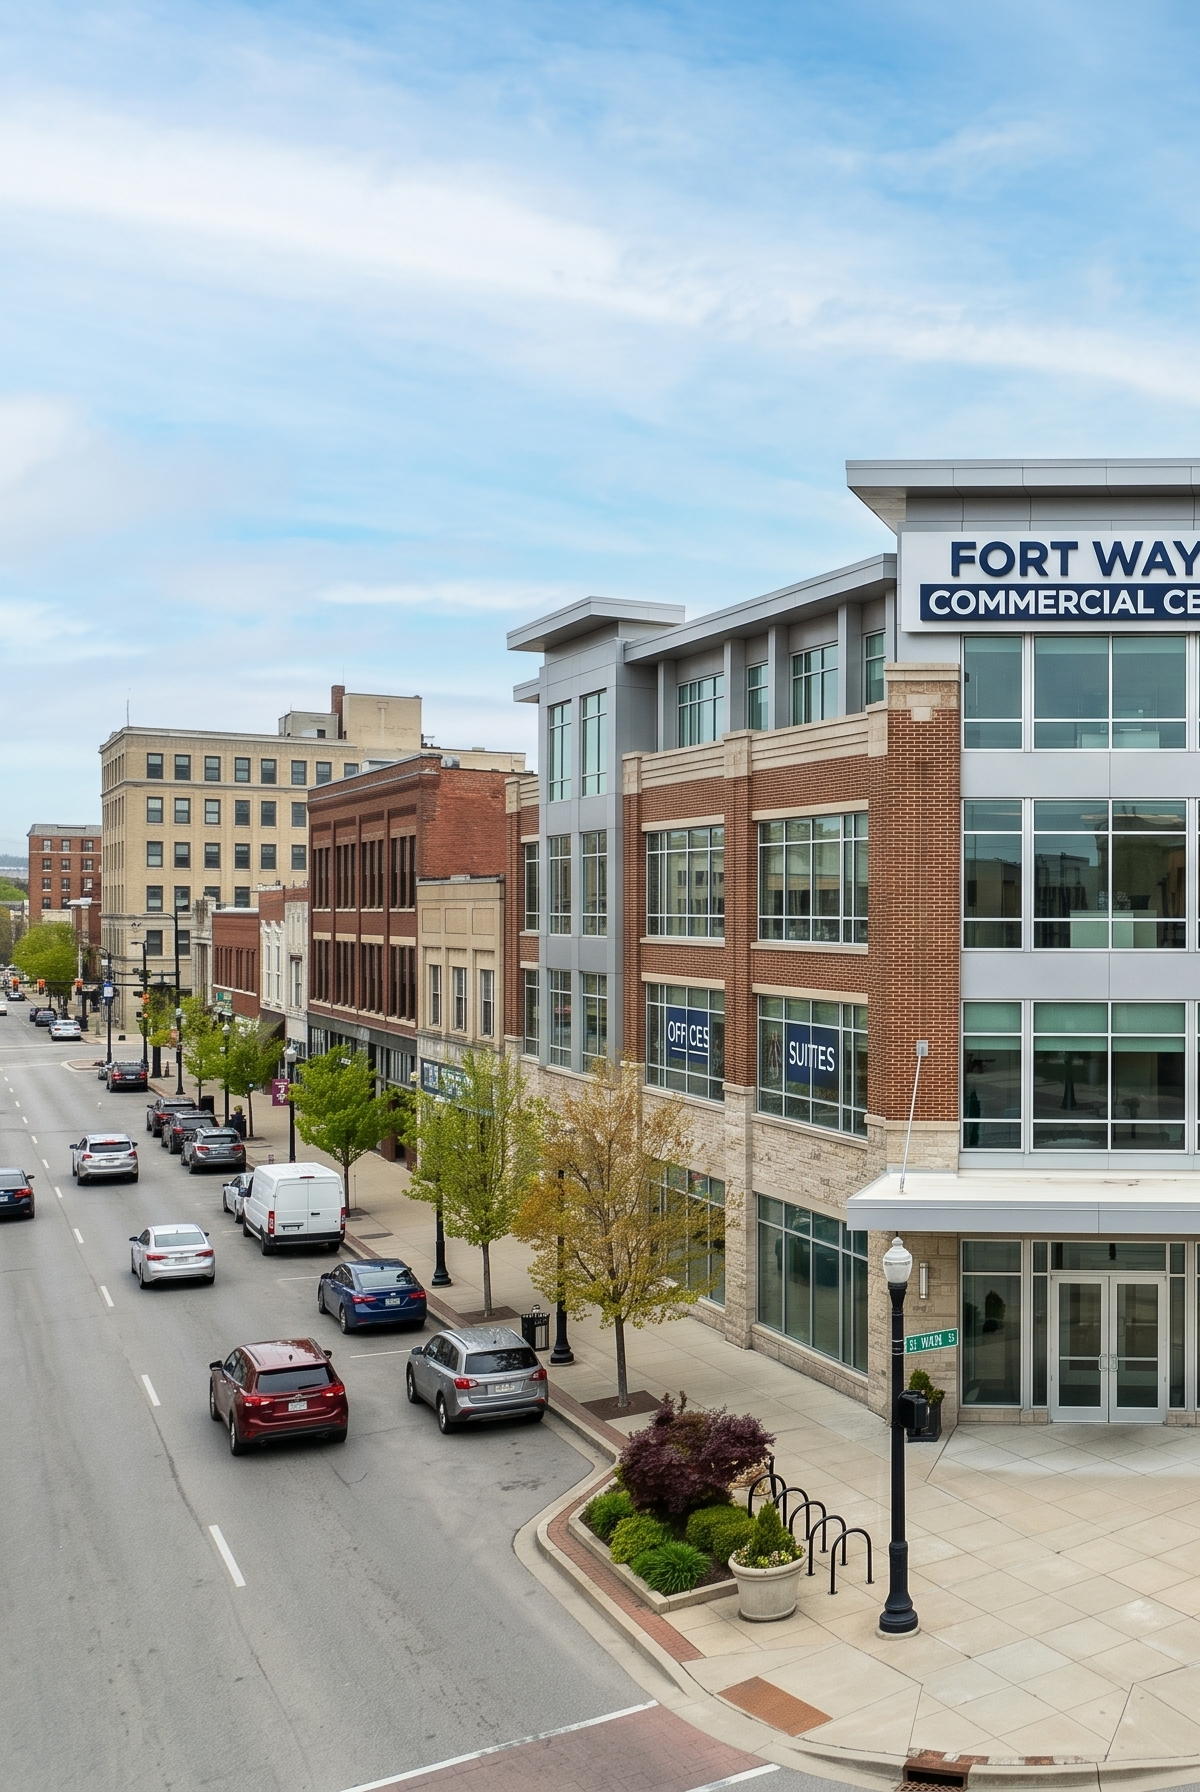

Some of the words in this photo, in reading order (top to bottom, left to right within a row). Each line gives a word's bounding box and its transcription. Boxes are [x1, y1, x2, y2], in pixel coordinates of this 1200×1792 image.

[951, 540, 1079, 577] FORT
[928, 589, 1155, 616] COMMERCIAL
[788, 1041, 835, 1072] SUITES
